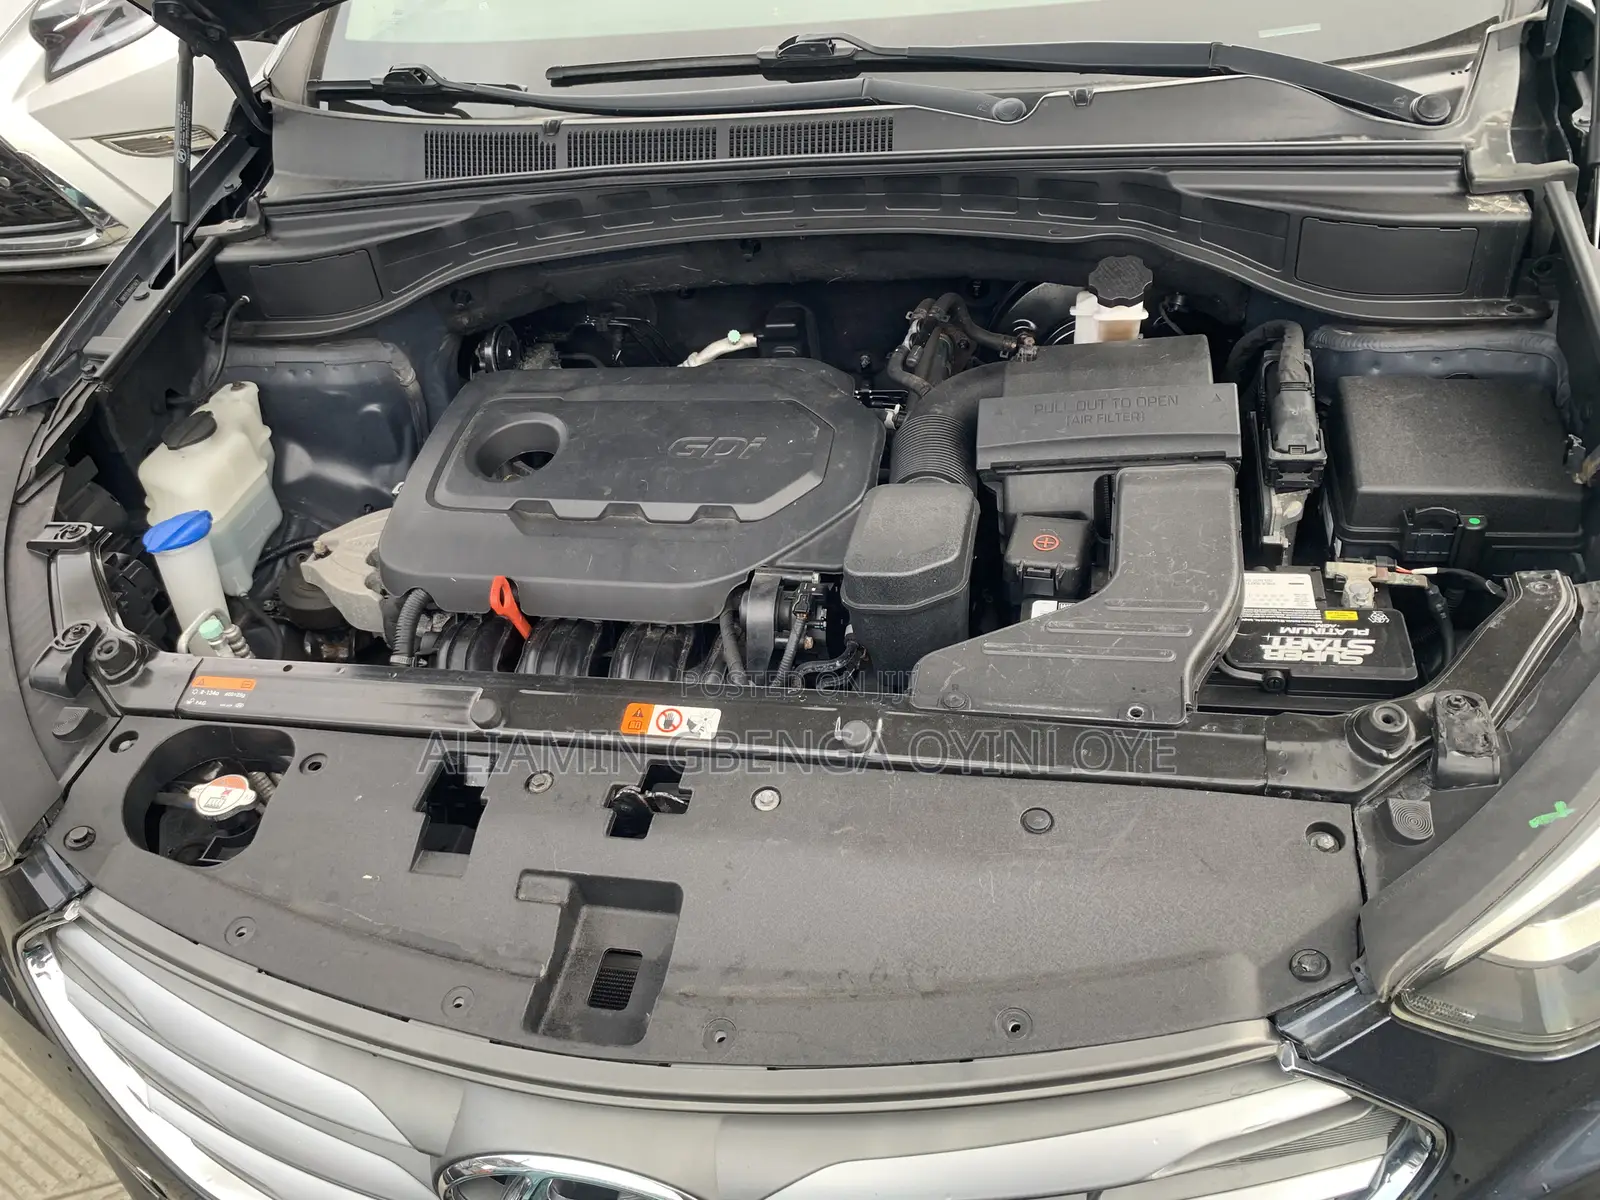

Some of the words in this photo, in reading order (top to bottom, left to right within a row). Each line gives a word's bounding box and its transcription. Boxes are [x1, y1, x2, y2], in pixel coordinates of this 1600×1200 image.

[1076, 399, 1106, 412] OUT
[1112, 397, 1132, 409] TO
[1136, 394, 1179, 408] OPEN
[1279, 626, 1371, 636] PLATINUM
[1259, 636, 1376, 655] START
[1262, 648, 1365, 665] SUPER
